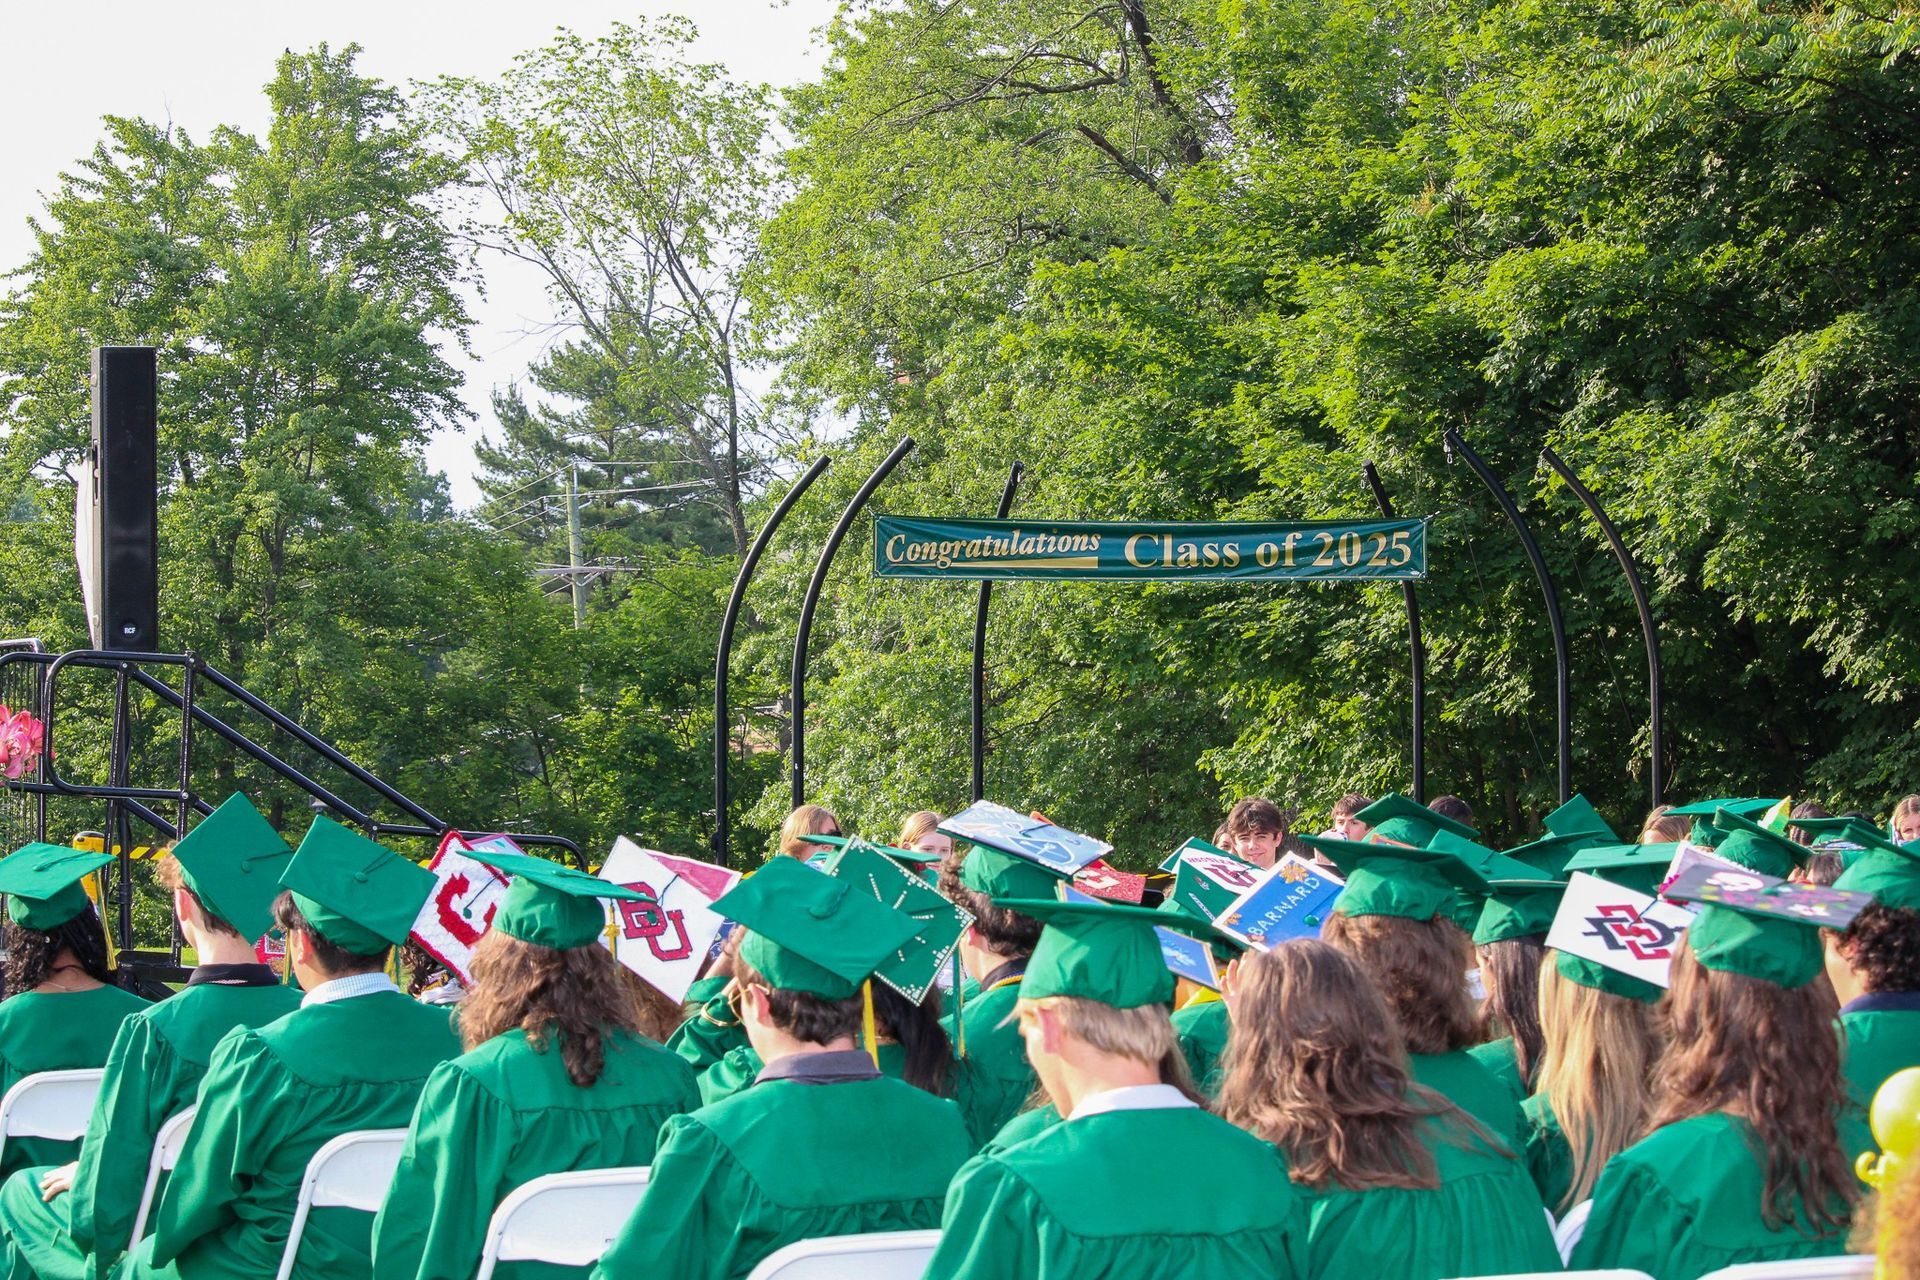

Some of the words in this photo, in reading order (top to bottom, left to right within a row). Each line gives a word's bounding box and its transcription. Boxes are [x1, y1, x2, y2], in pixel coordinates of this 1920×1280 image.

[885, 528, 1101, 569] Congratulations
[1124, 533, 1240, 568] Class
[1255, 532, 1302, 567] of
[1312, 531, 1411, 567] 2025
[1247, 876, 1320, 936] BARNARD
